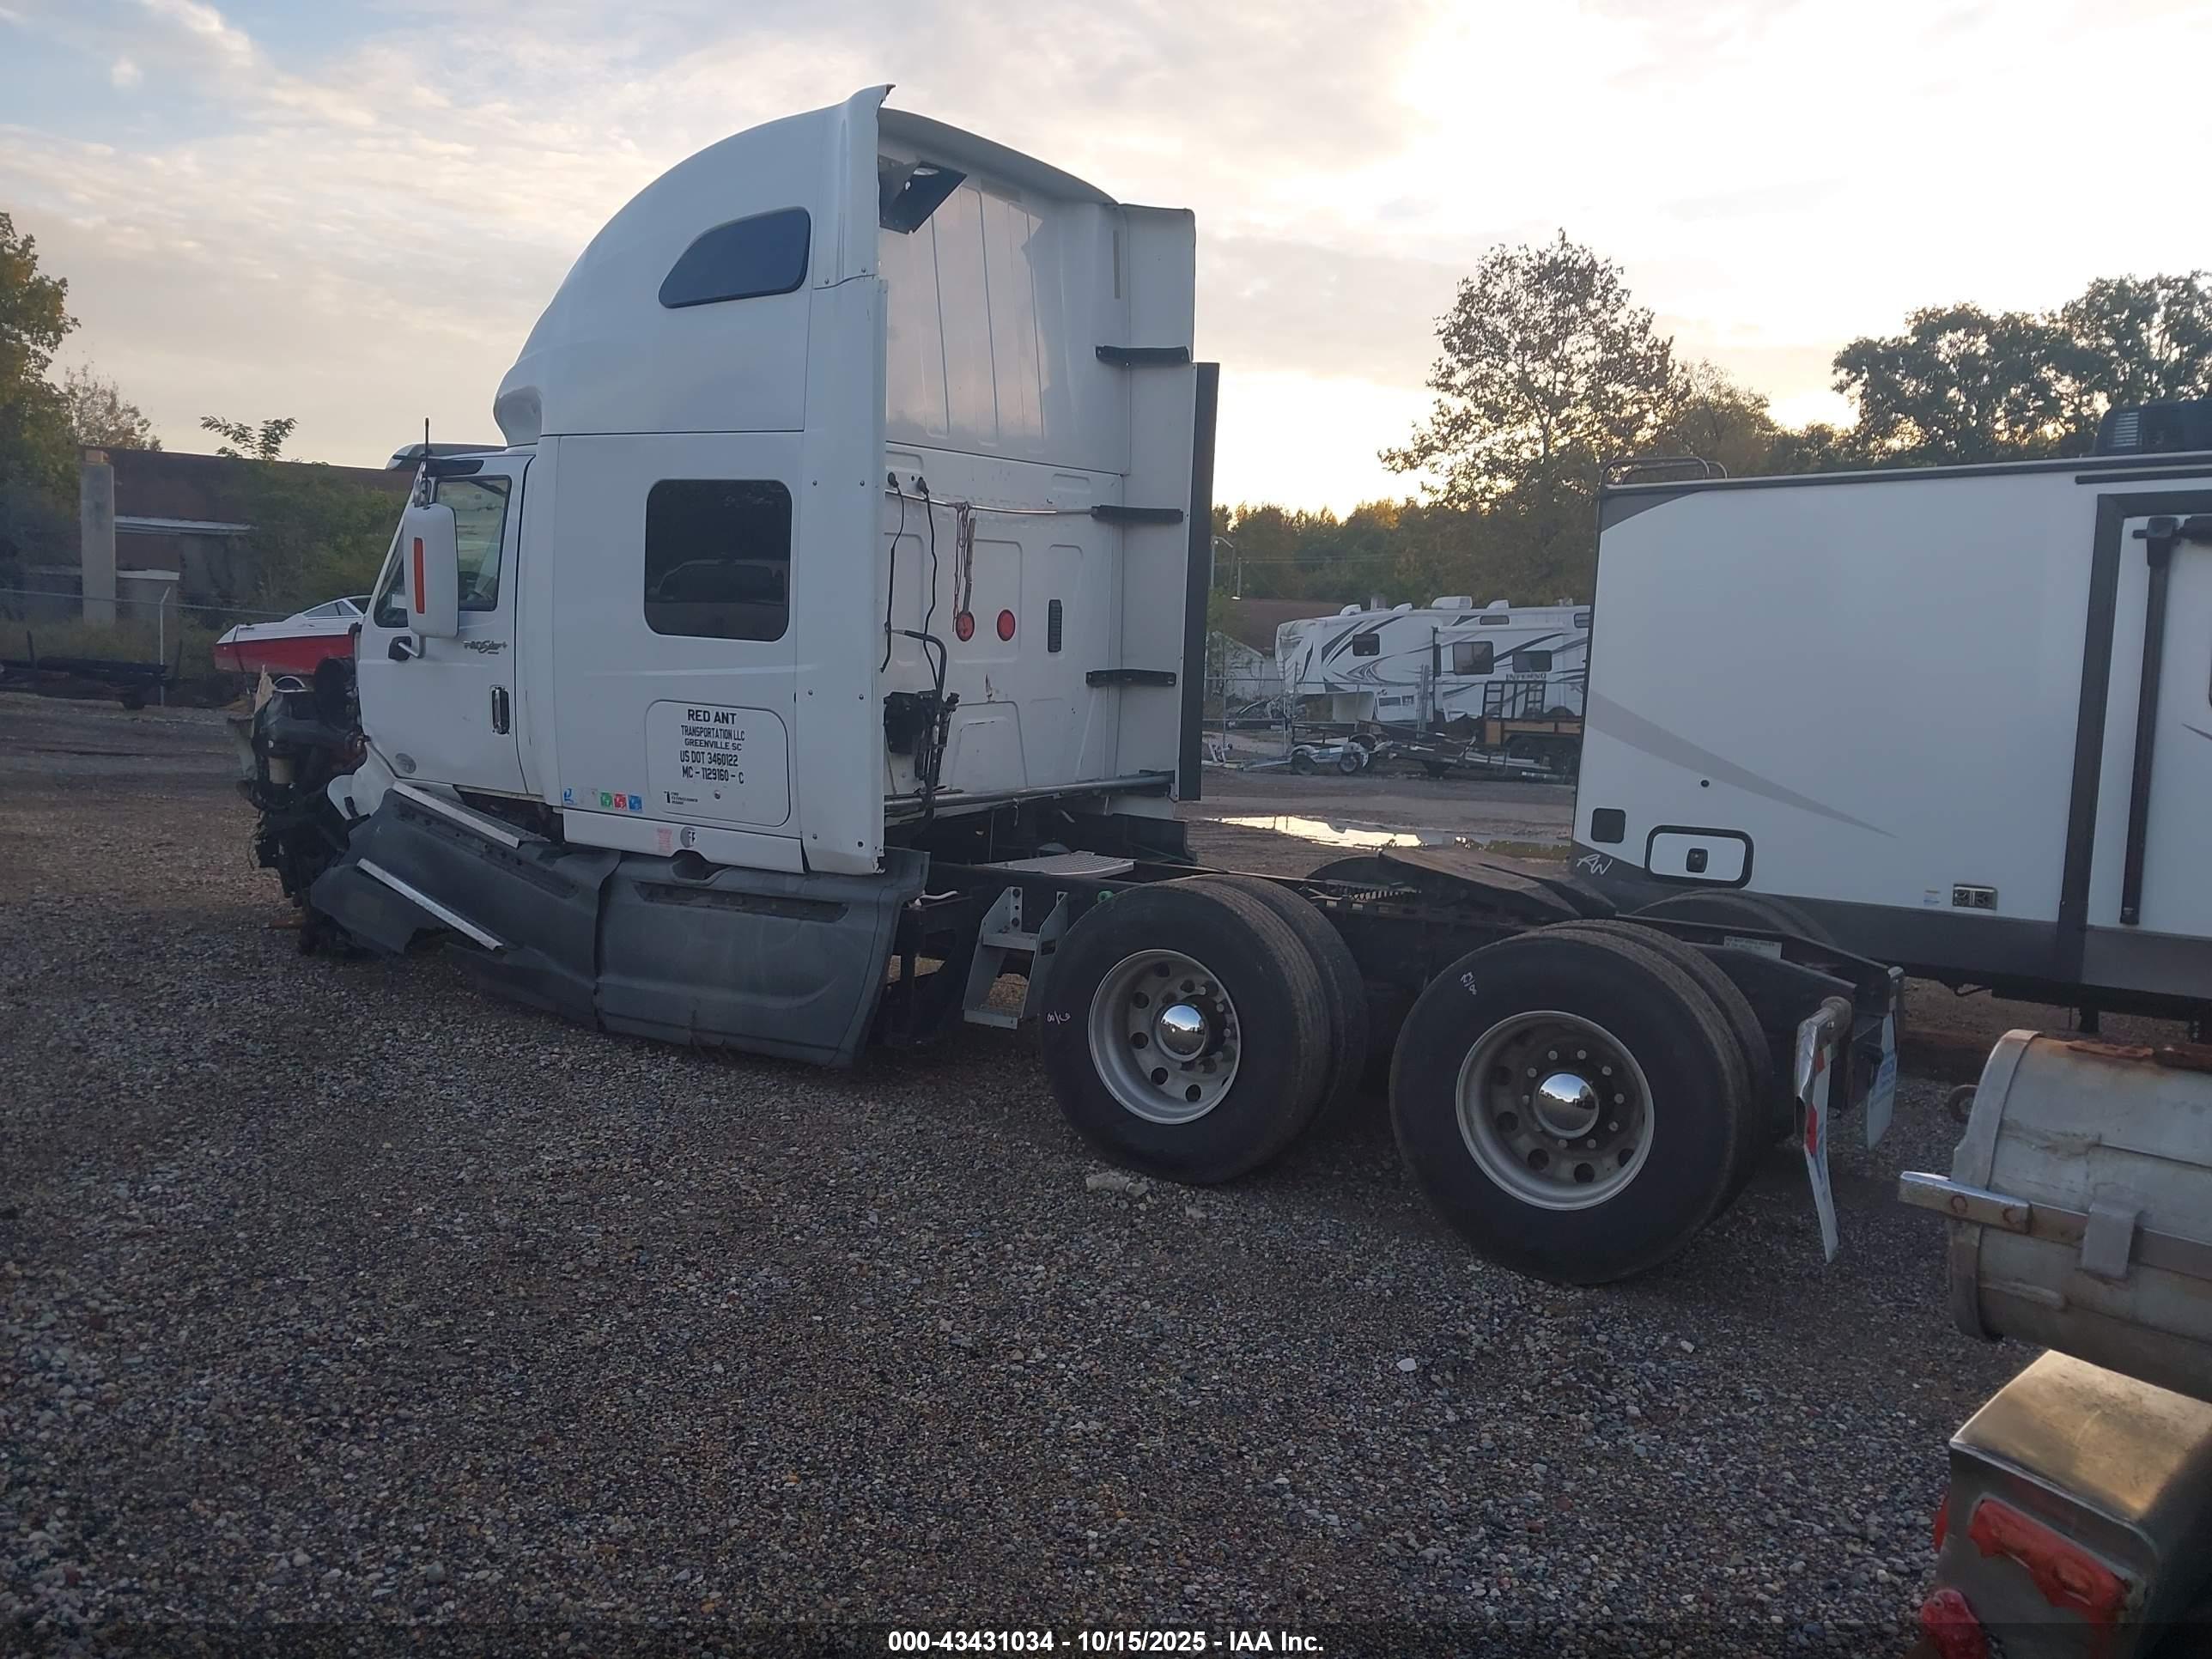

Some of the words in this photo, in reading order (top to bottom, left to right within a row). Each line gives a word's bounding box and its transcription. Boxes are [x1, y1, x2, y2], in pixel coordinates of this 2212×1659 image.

[688, 708, 710, 722] RED
[714, 711, 737, 725] ANT
[681, 725, 732, 740] TRANSPORTATION
[733, 730, 745, 741] LLC
[684, 738, 730, 750] GREENVILLE
[732, 743, 742, 751] SC
[680, 750, 690, 763] US
[691, 750, 705, 764] DOT
[708, 752, 738, 767] 3460122
[682, 766, 693, 778] MC
[702, 767, 729, 781] 1129160
[738, 772, 744, 784] C
